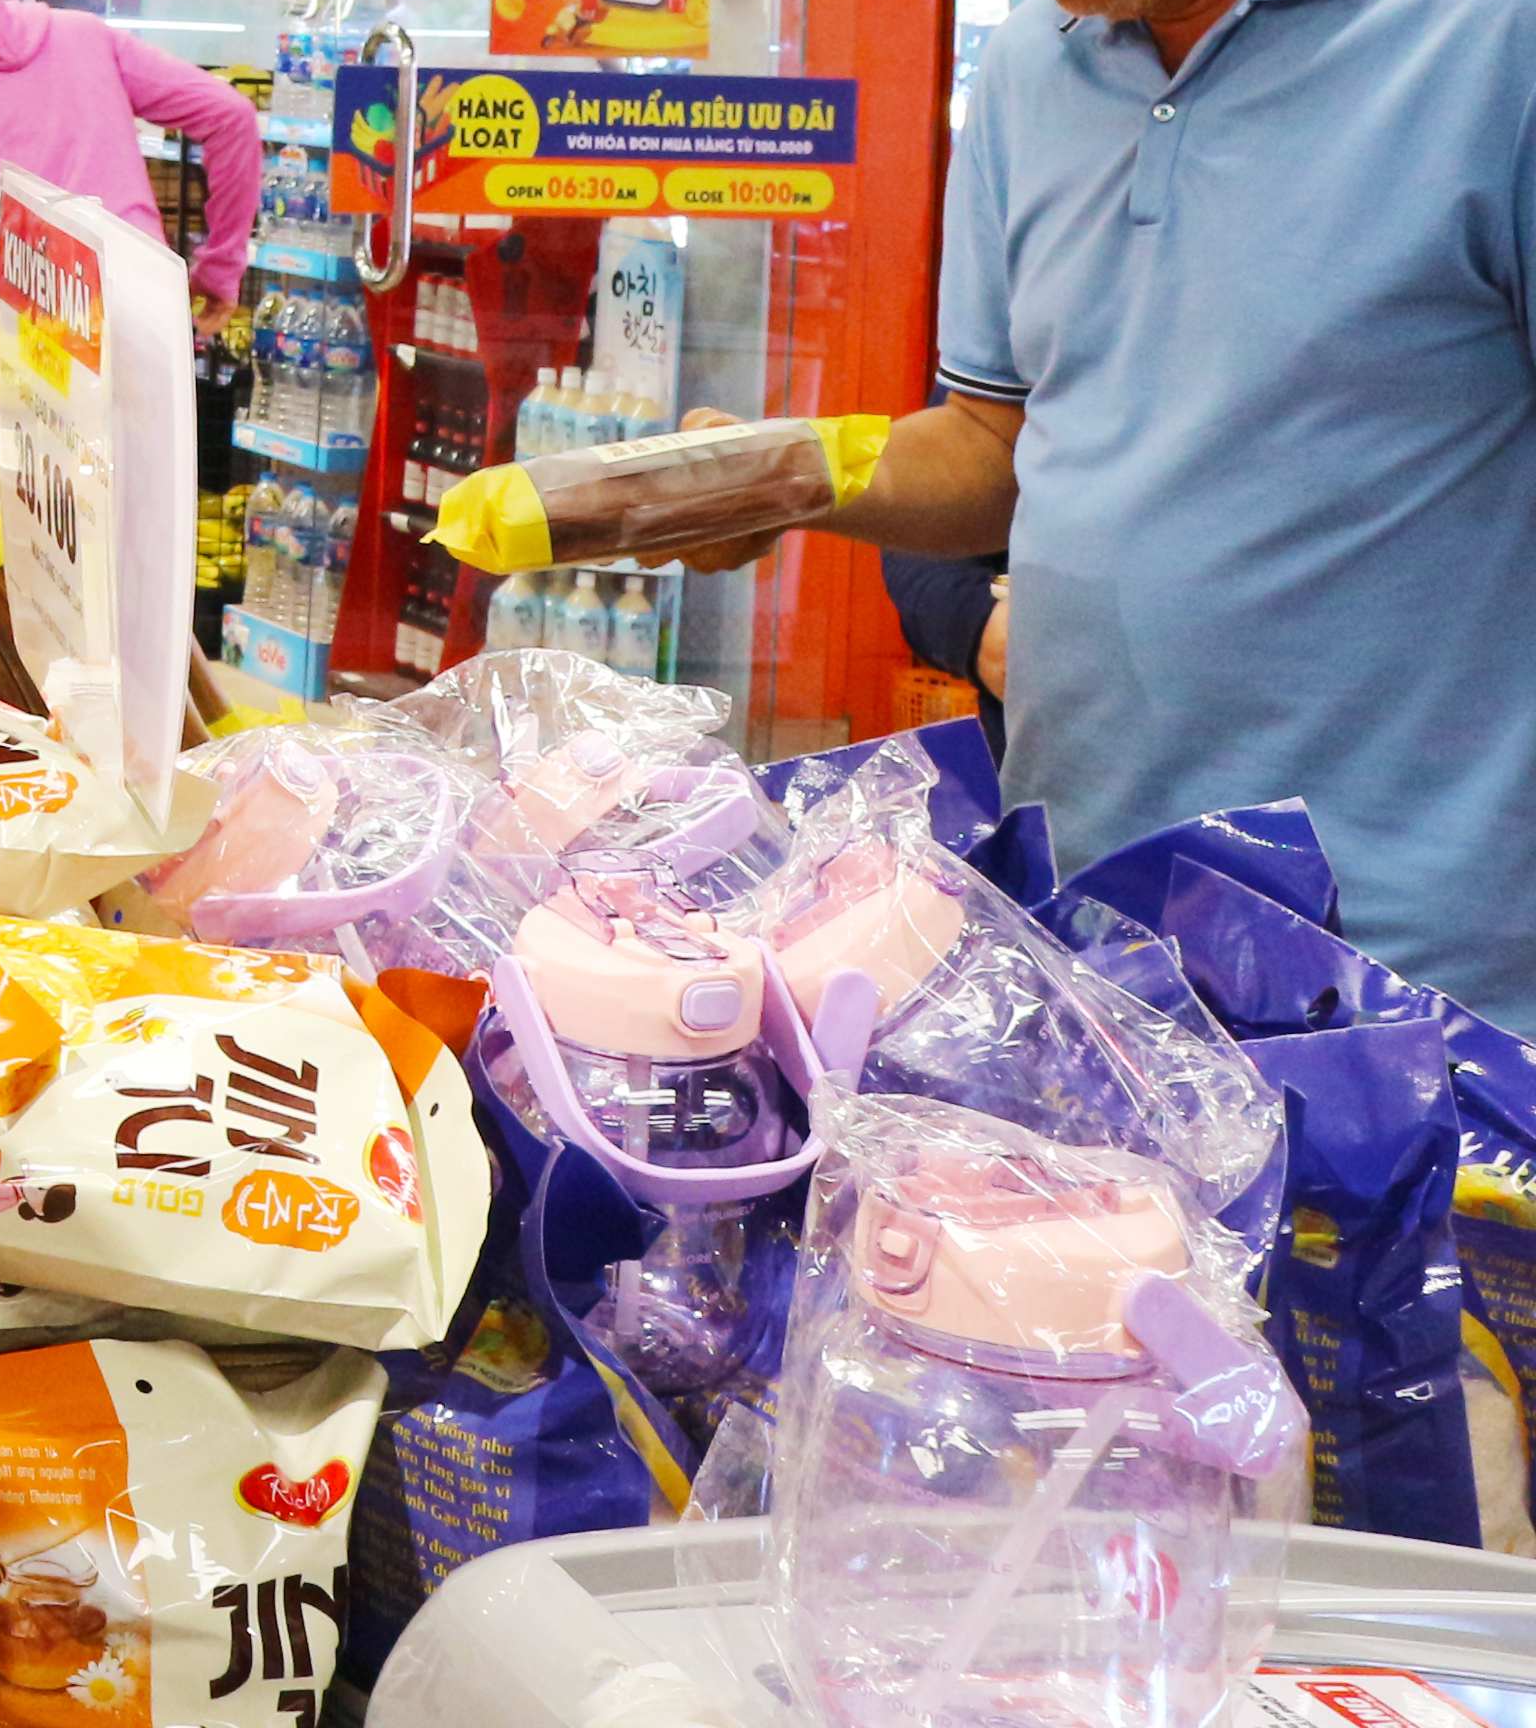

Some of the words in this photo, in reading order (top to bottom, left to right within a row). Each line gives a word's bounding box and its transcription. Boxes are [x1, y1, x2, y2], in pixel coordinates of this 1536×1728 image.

[457, 92, 525, 121] HÀNG
[546, 89, 603, 127] SẢN
[606, 89, 686, 129] PHẨM
[690, 94, 744, 131] SIÊU
[787, 98, 835, 132] ĐÃI
[460, 127, 521, 155] LOẠT
[663, 138, 692, 153] MUA
[694, 134, 735, 154] HÀNG
[507, 186, 543, 200] OPEN
[547, 176, 615, 201] 06:30
[616, 187, 638, 201] AM
[685, 189, 724, 204] CLOSE
[728, 179, 793, 205] 10:00
[793, 191, 813, 205] PM
[4, 229, 57, 317] KHUYẾN
[59, 260, 90, 341] MÃI
[611, 264, 658, 317] 아침
[17, 1465, 36, 1480] ong
[480, 1460, 513, 1477] cho
[29, 1488, 83, 1506] Cholesterol
